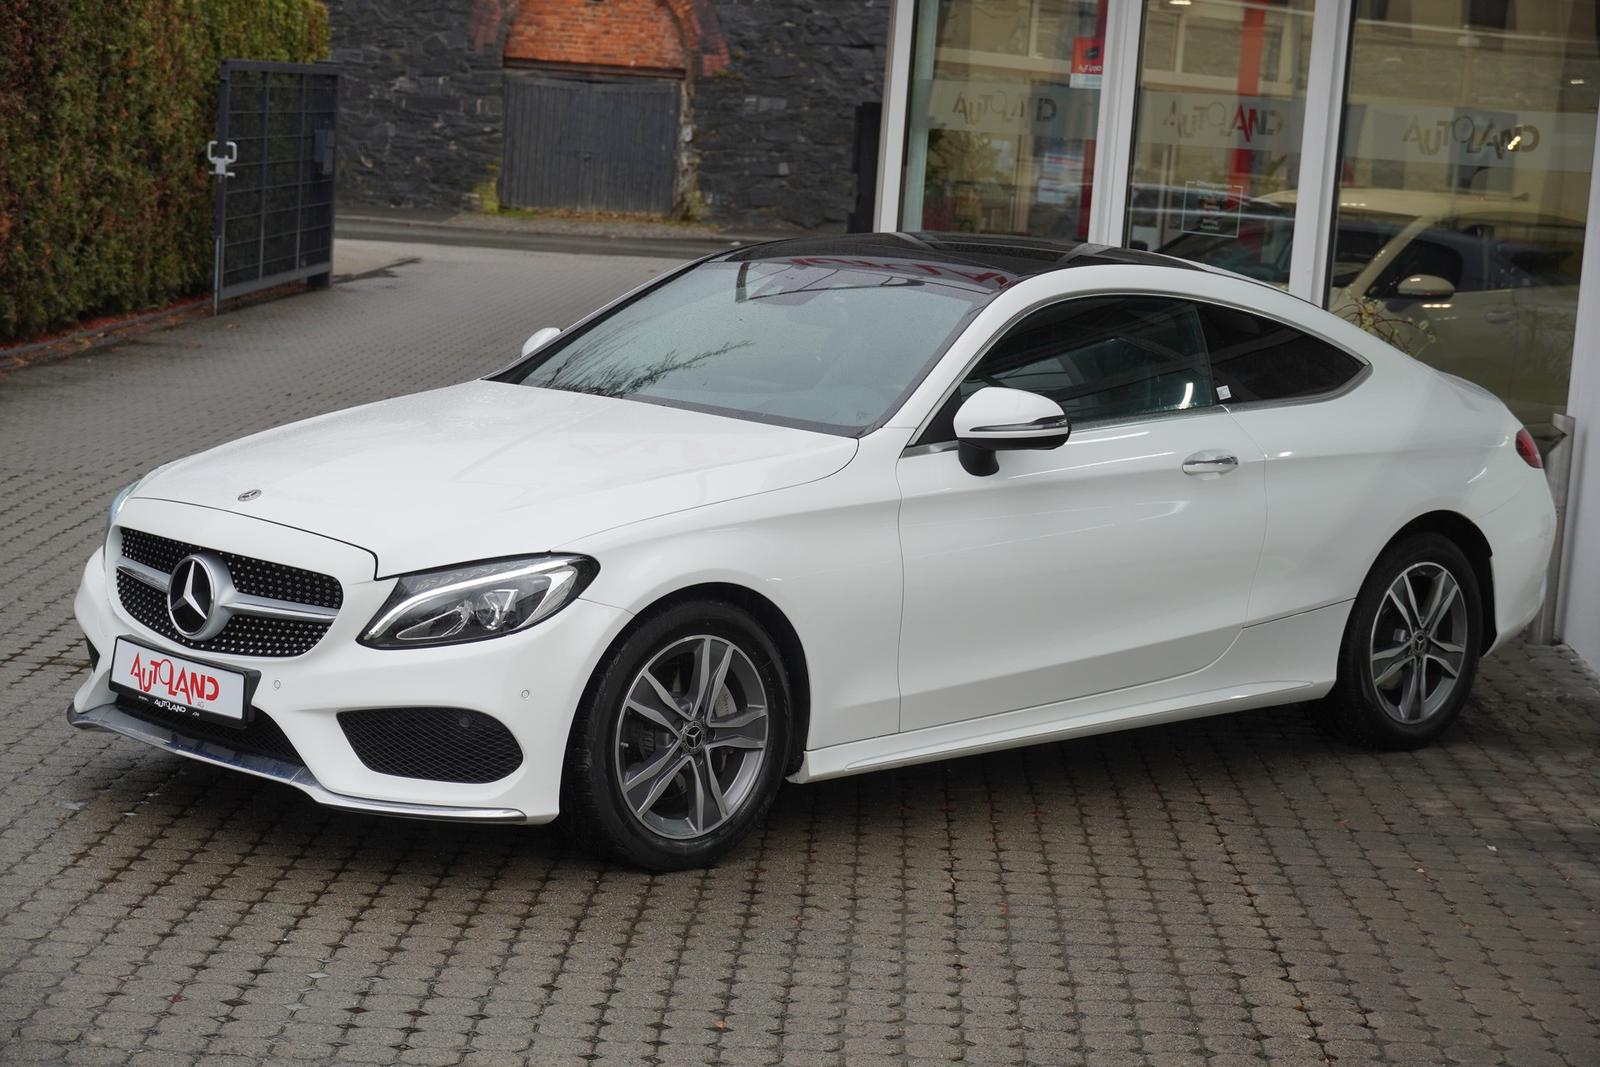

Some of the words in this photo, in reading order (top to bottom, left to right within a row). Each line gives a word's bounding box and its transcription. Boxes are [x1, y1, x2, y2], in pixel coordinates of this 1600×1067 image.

[1402, 114, 1540, 160] AUTOLAND
[130, 651, 219, 705] AUTOLAND
[154, 699, 187, 713] AUTOLAND
